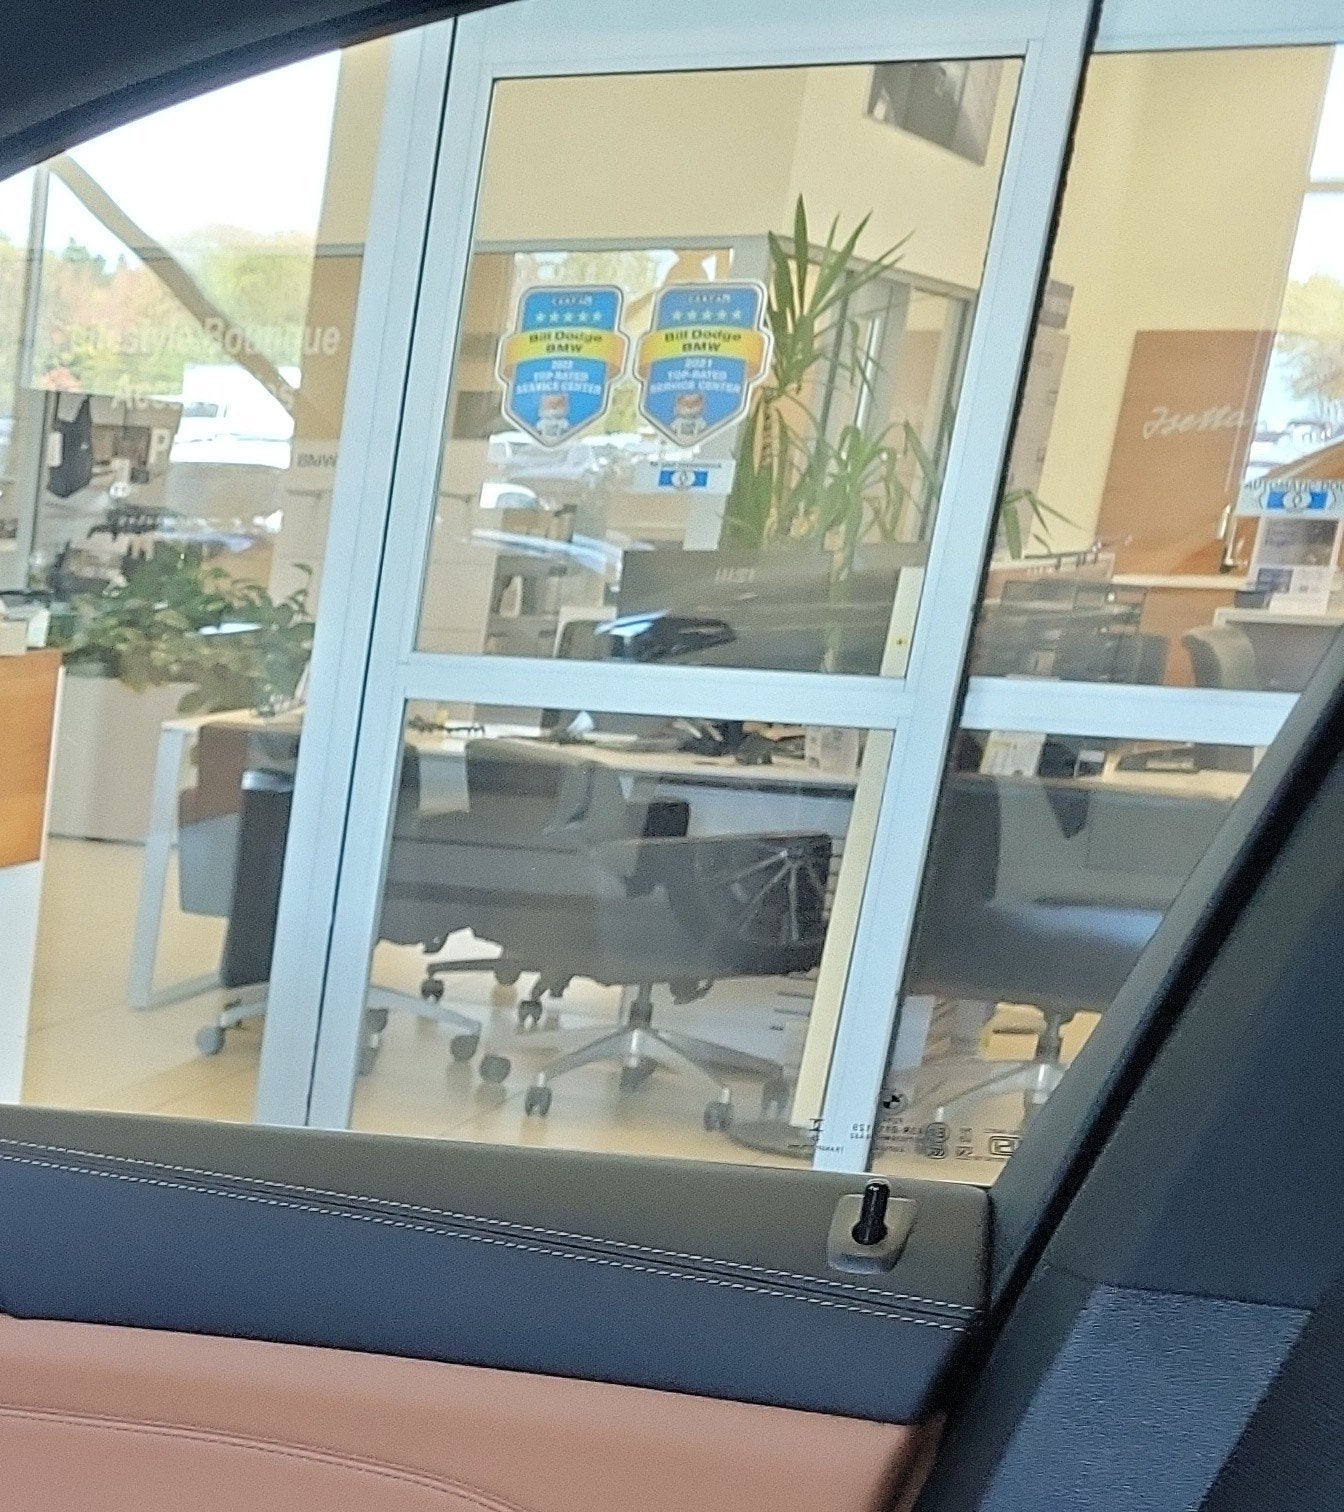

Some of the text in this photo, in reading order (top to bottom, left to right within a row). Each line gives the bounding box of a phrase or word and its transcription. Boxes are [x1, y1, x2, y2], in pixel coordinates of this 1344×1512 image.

[529, 330, 602, 343] Bill Dodge
[665, 329, 742, 343] Bill Dodge
[546, 343, 583, 353] BMW
[682, 342, 721, 352] BMW
